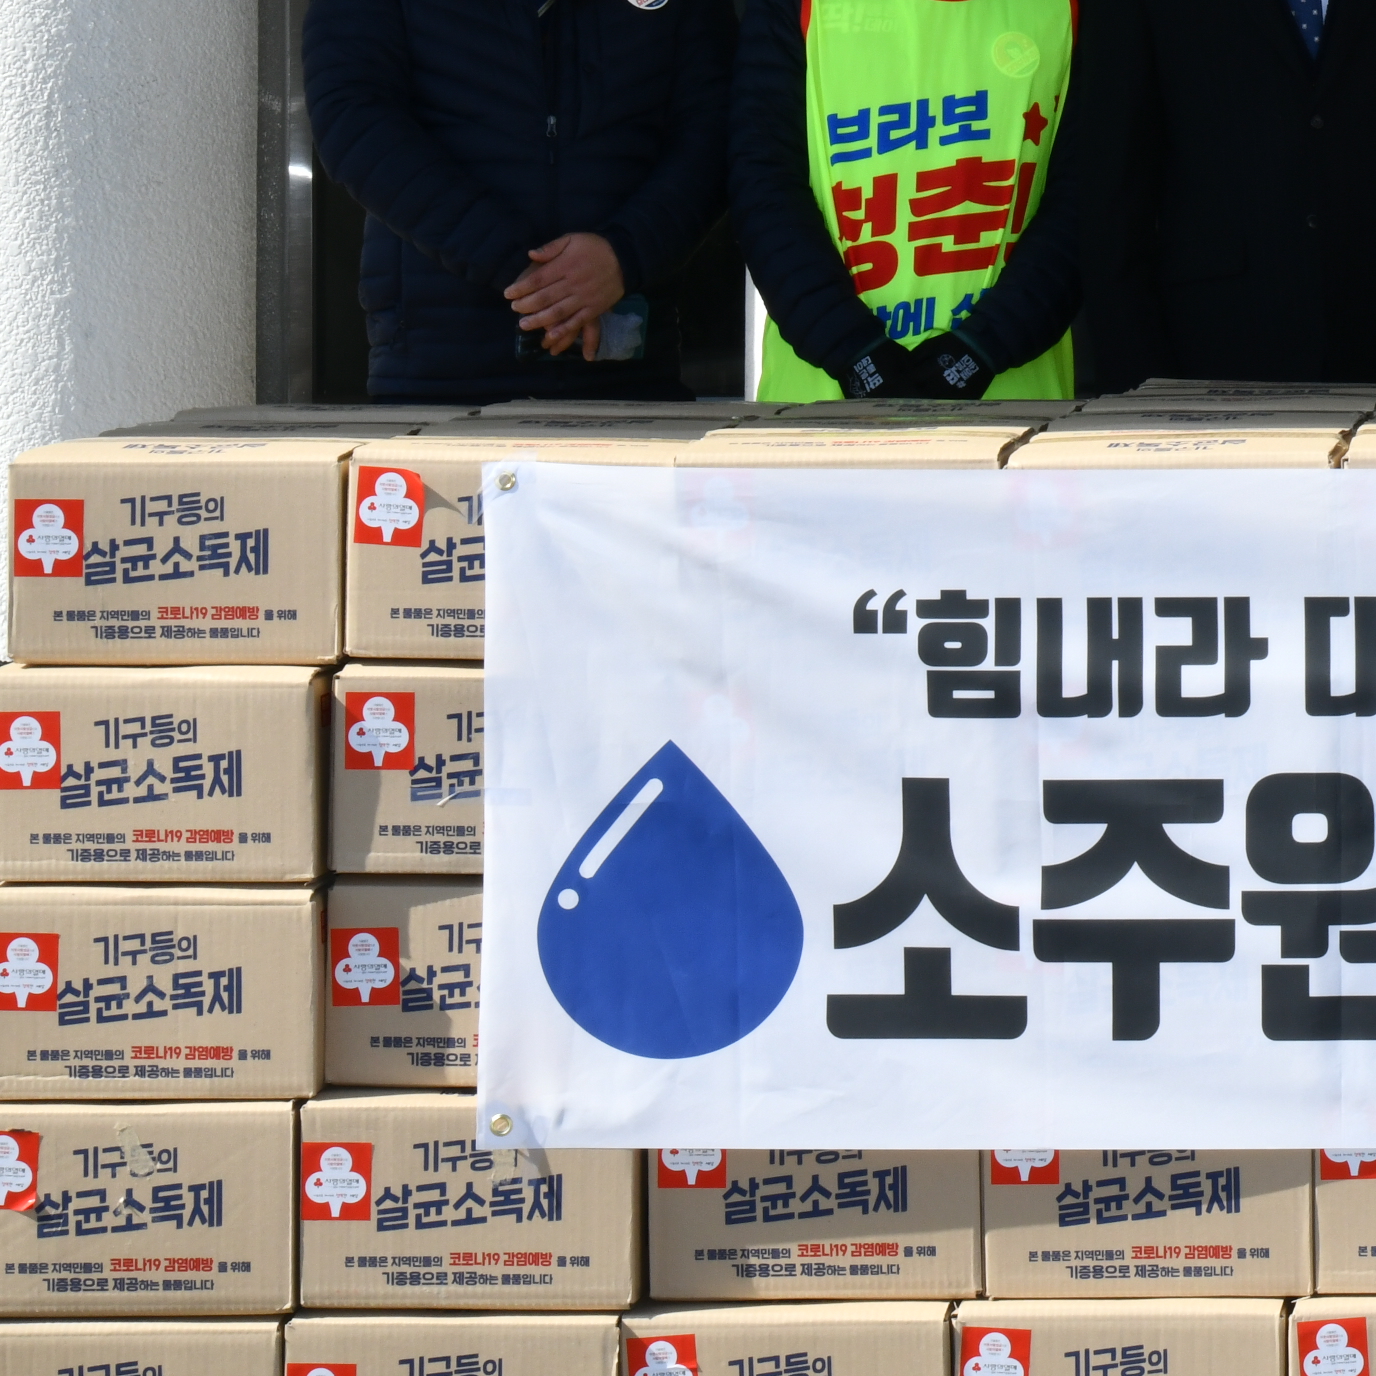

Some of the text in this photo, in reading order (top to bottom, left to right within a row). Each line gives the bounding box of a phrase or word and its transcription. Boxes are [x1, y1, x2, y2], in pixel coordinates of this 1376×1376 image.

[827, 90, 991, 166] 브라보
[121, 492, 224, 527] 기구등의
[83, 528, 269, 587] 살균소독제
[53, 609, 63, 622] 본
[66, 609, 96, 622] 물품은
[99, 609, 150, 622] 지역민들의
[156, 605, 208, 621] 코로나19
[210, 605, 259, 621] 감염예방
[277, 609, 297, 621] 위해
[90, 625, 260, 640] 기증용으로 제공하는 물품입니다
[94, 714, 197, 749] 기구등의
[60, 750, 243, 809] 살균소독제
[94, 931, 197, 966] 기구등의
[57, 965, 243, 1026] 살균소독제
[35, 1179, 223, 1239] 살균소독제
[374, 1172, 564, 1233] 살균소독제
[722, 1164, 909, 1226] 살균소독제
